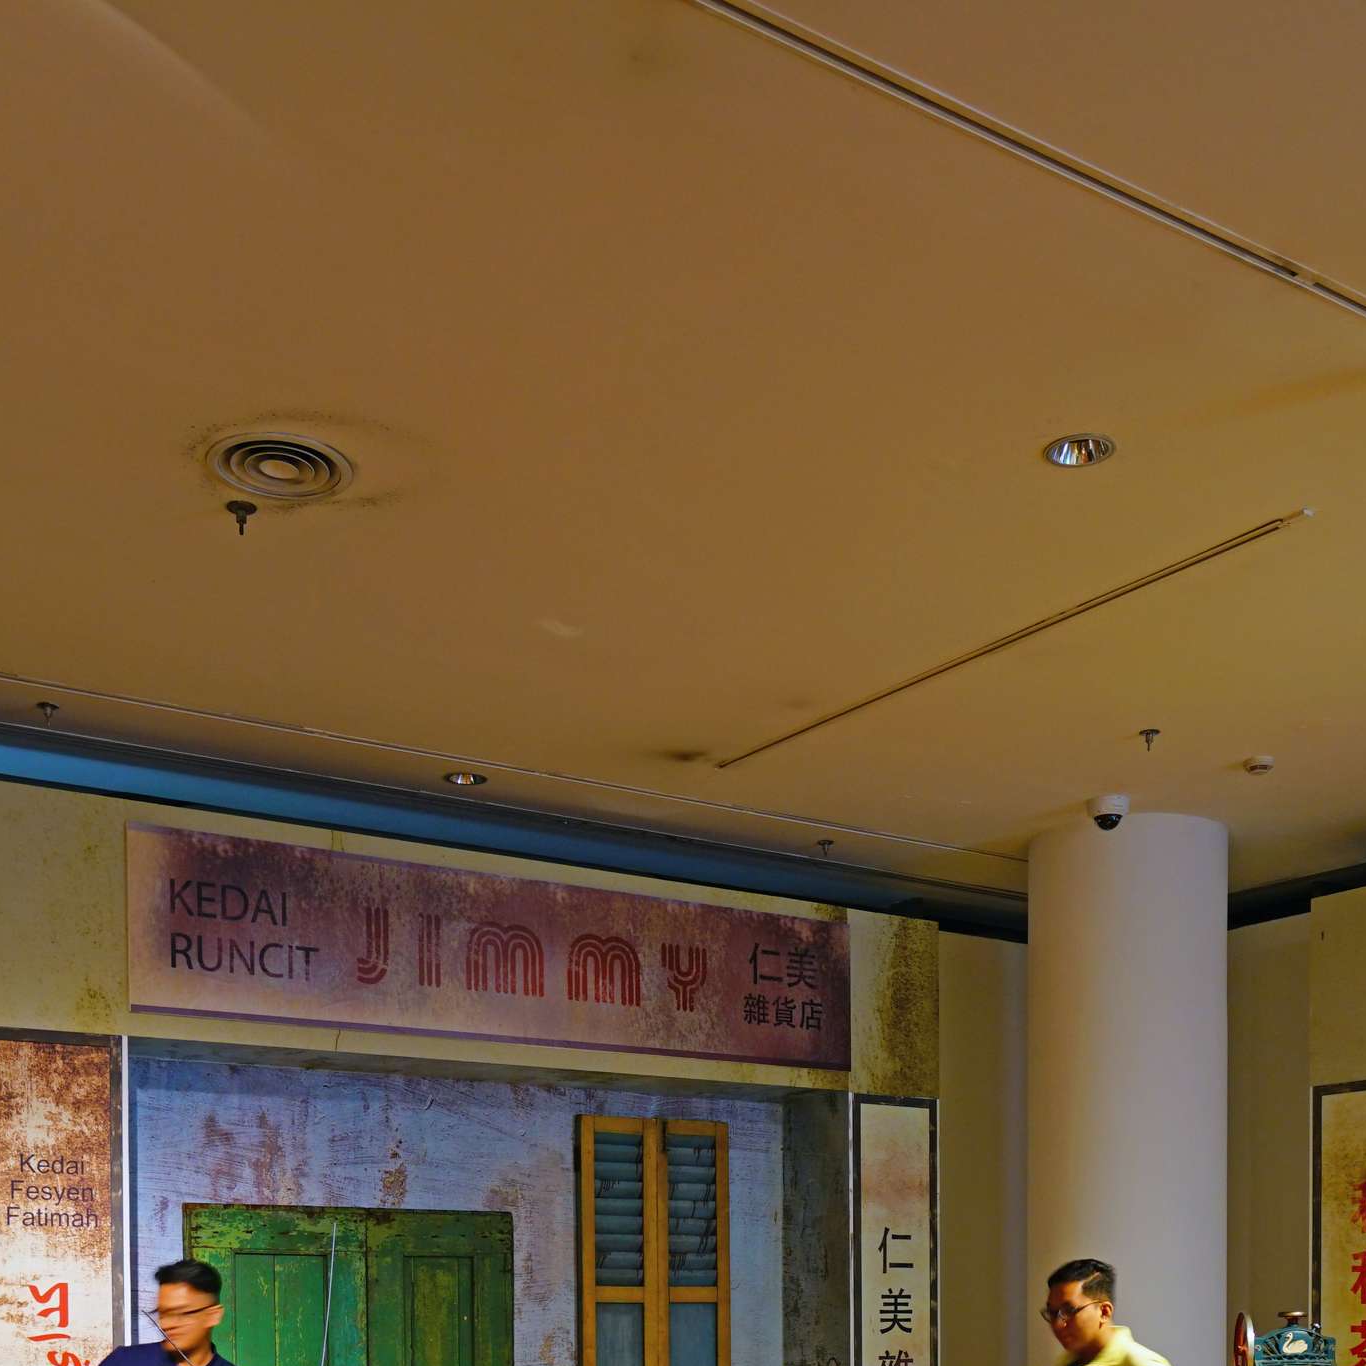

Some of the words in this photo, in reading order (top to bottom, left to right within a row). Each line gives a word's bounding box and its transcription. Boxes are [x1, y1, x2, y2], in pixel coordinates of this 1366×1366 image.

[169, 878, 288, 927] KEDAI
[169, 932, 320, 982] RUNCIT
[748, 942, 819, 990] 仁美
[743, 993, 823, 1032] 雜貨店
[19, 1153, 85, 1176] Kedai
[9, 1180, 94, 1206] Fesyen
[6, 1206, 98, 1229] Fatimah
